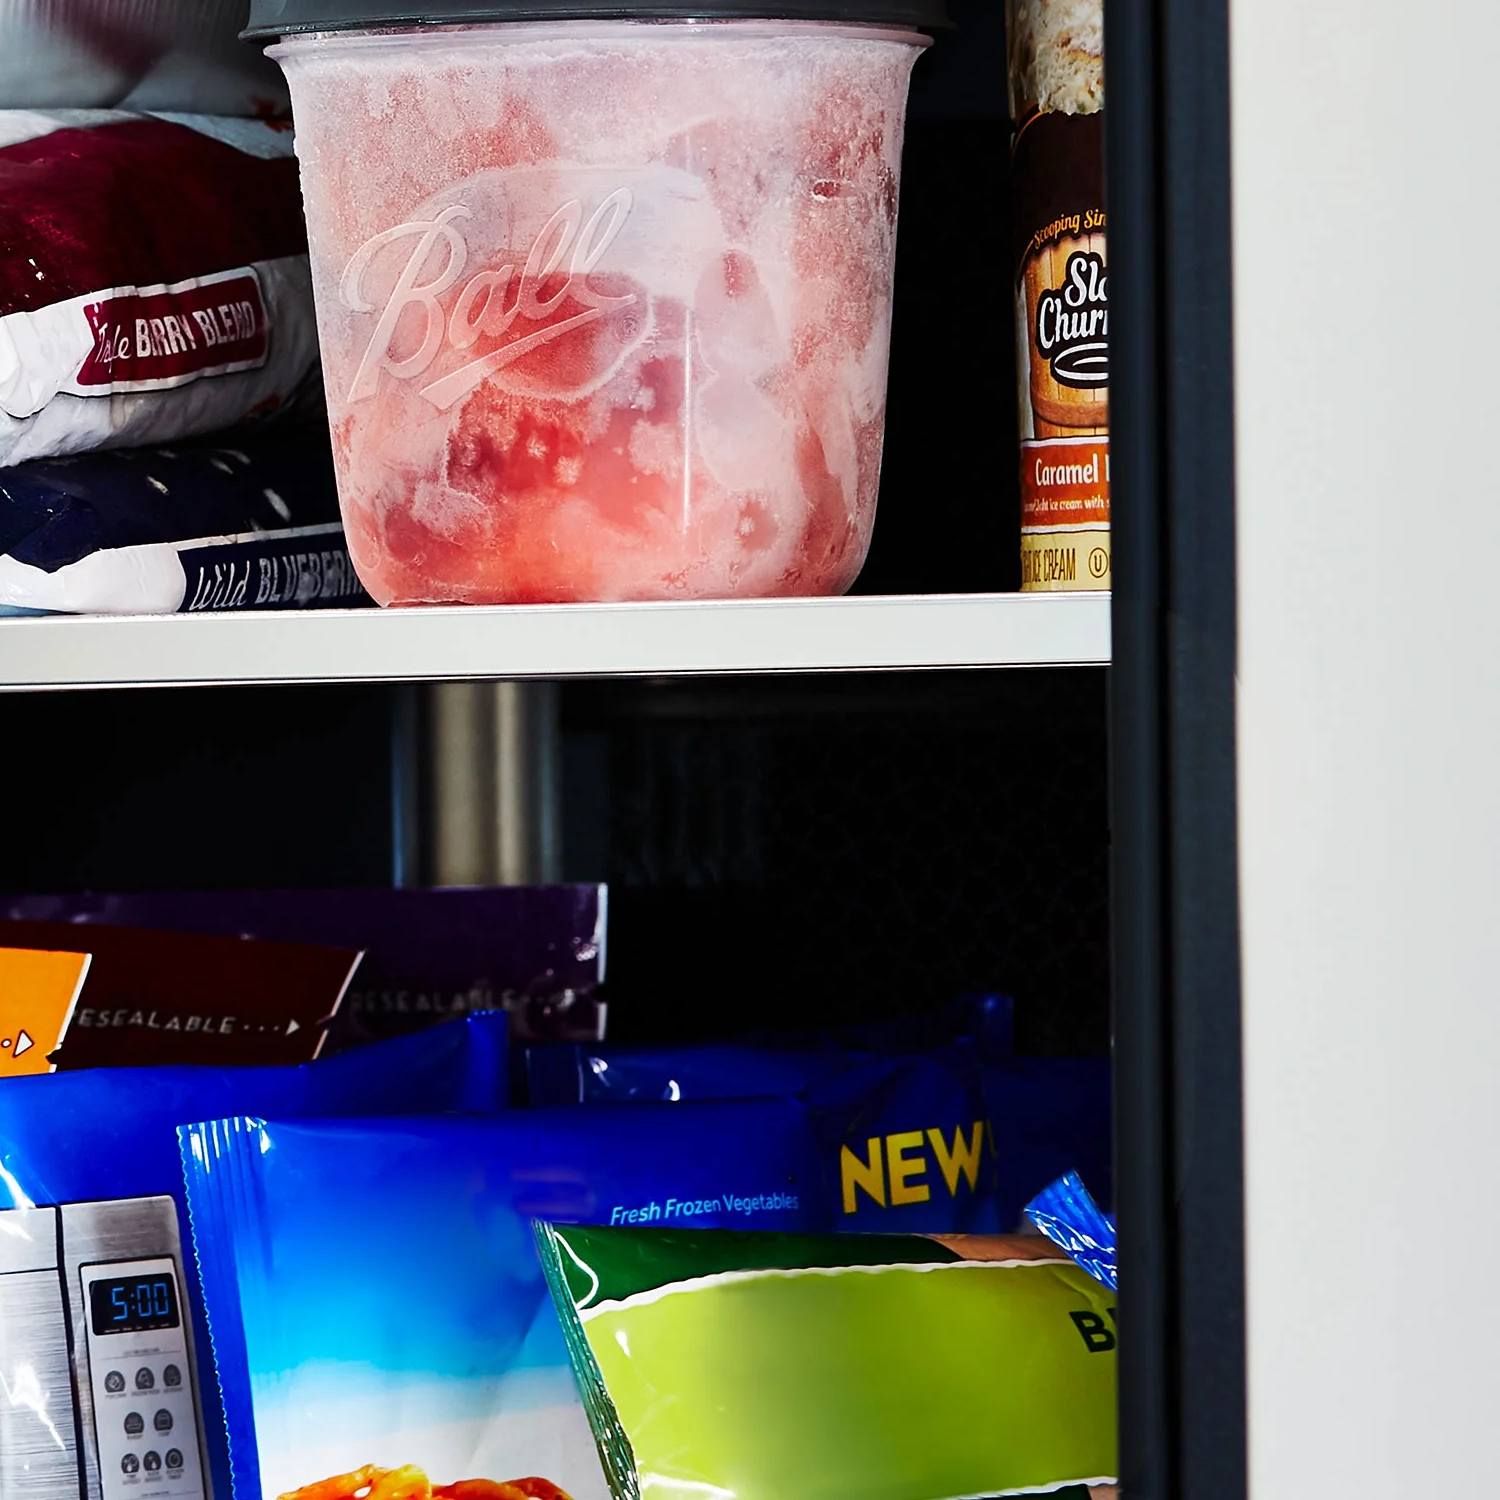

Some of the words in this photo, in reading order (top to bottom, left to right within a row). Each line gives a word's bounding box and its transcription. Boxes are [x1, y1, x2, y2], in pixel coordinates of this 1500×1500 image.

[339, 188, 637, 403] Ball
[1035, 453, 1098, 486] Caramel
[1084, 494, 1104, 510] with
[1043, 547, 1076, 582] CREAM
[189, 560, 250, 611] Wild
[75, 1008, 237, 1035] ESEALABLE
[840, 1120, 985, 1215] NEW
[610, 1200, 661, 1226] Fresh
[664, 1195, 722, 1219] Frozen
[722, 1192, 800, 1216] Vegetables
[112, 1282, 169, 1320] 5:00
